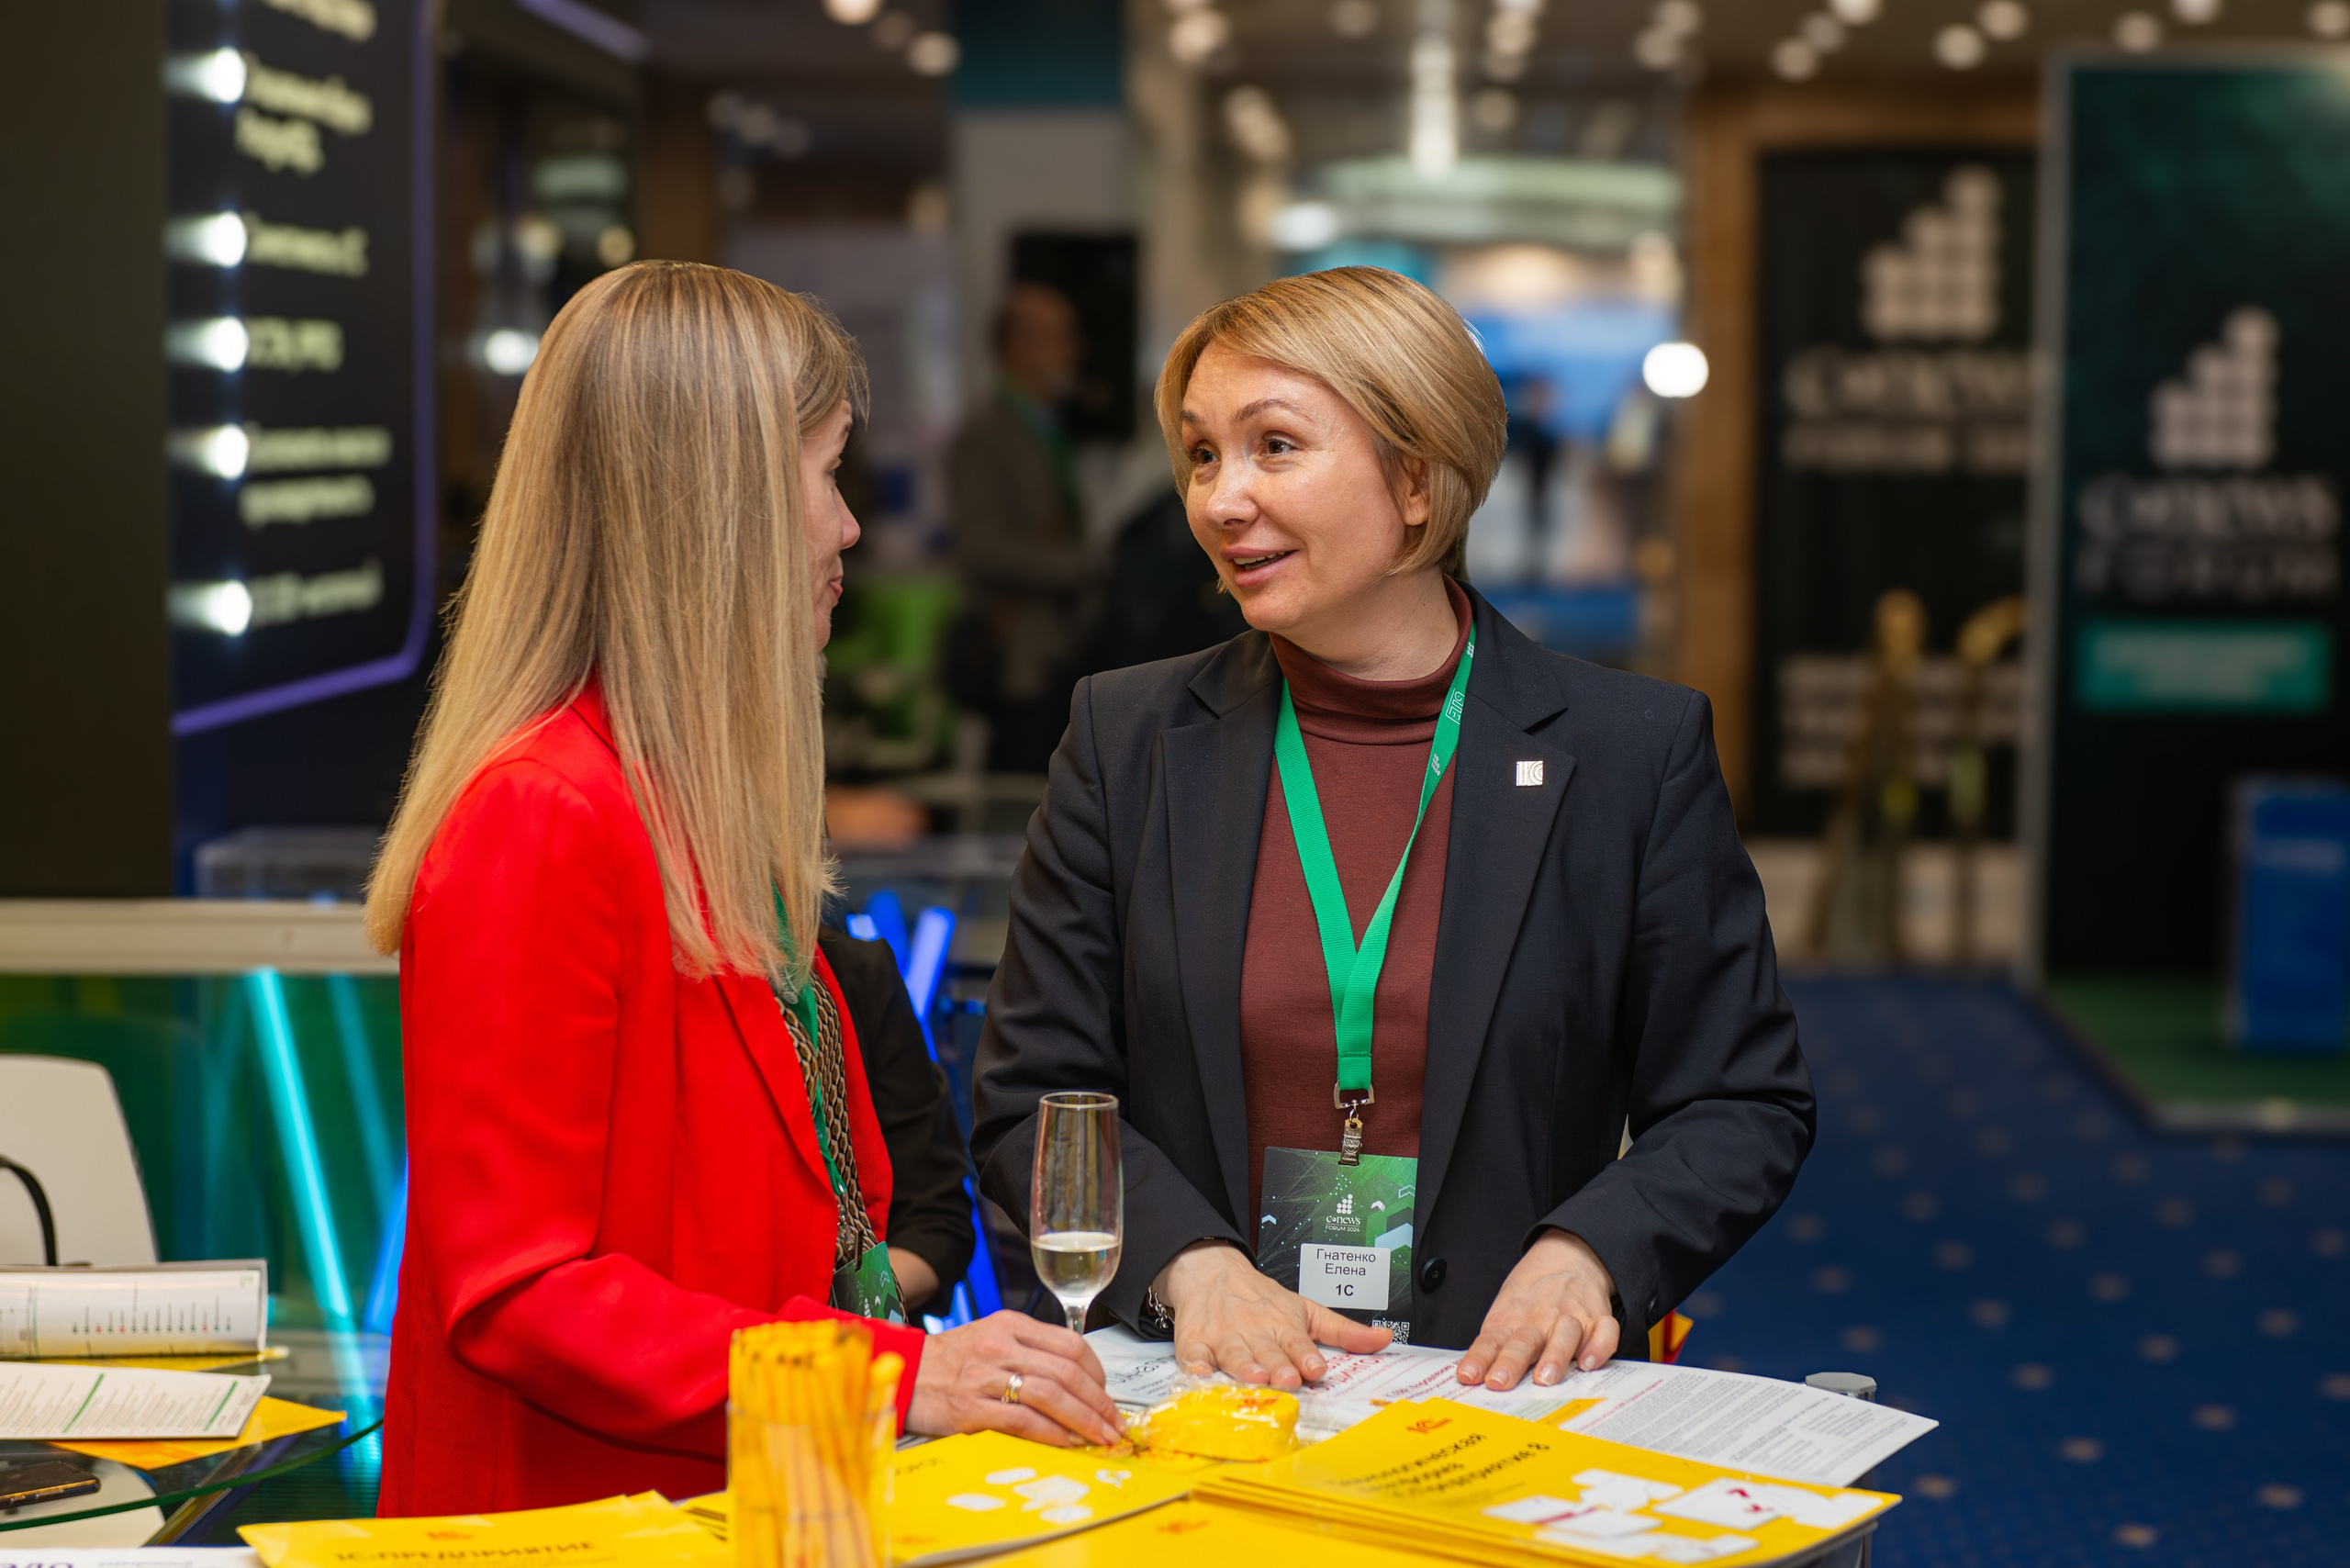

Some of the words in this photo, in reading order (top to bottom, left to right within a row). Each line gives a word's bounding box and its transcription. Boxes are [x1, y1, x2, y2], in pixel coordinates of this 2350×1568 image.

[1316, 1249, 1376, 1263] Гнатенко
[1325, 1262, 1366, 1276] Елена
[1336, 1284, 1354, 1296] 1С
